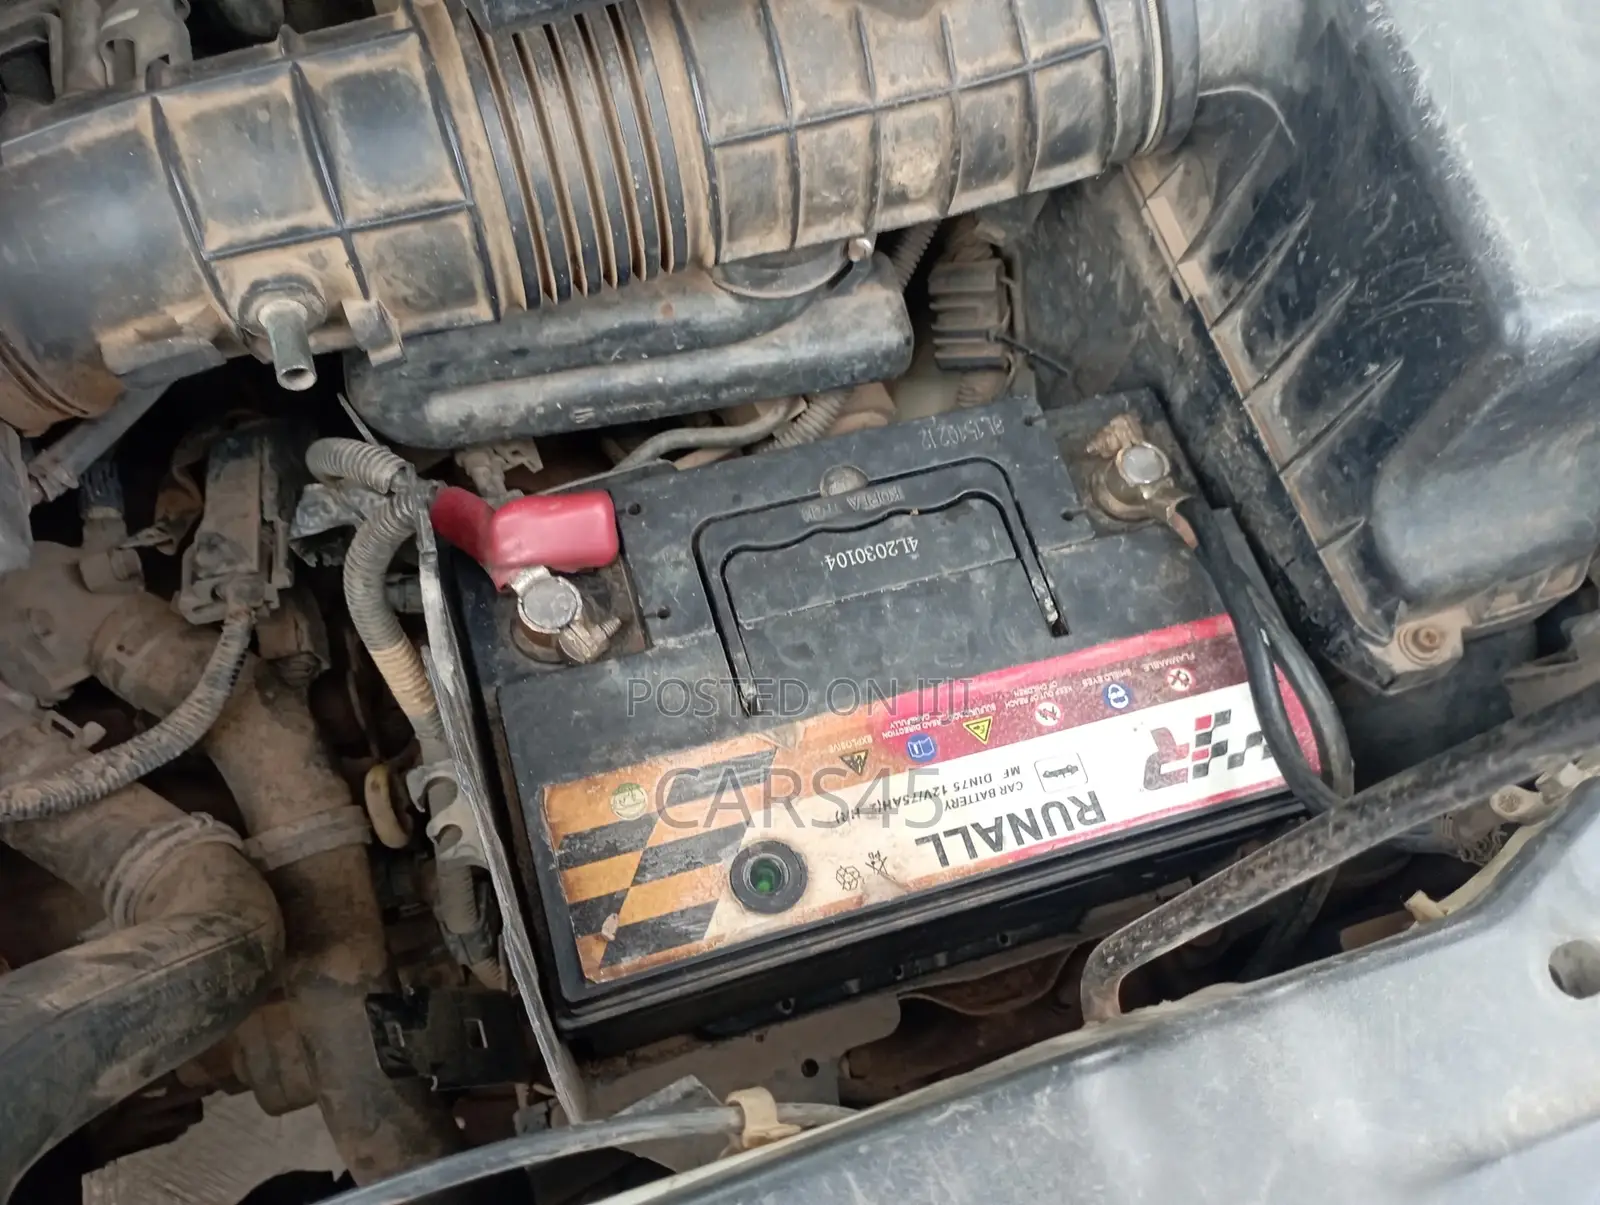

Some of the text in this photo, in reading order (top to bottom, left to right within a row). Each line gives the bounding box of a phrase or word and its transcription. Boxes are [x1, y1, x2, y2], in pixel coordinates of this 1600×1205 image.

[824, 536, 919, 571] 4L2030104
[1143, 652, 1196, 673] FLAMMABLE
[1081, 668, 1132, 688] SHIELD EYES
[1013, 683, 1048, 698] CHILDREN
[1040, 690, 1054, 701] OUT
[1055, 685, 1073, 696] KEEP
[1004, 697, 1029, 709] REACH
[882, 724, 922, 740] DIRECTION
[828, 734, 873, 753] EXPLOSIVE
[1003, 765, 1021, 779] MF
[953, 773, 993, 792] DIN75
[944, 781, 1024, 812] CAR BATTERY
[914, 791, 1106, 868] RUNALL
